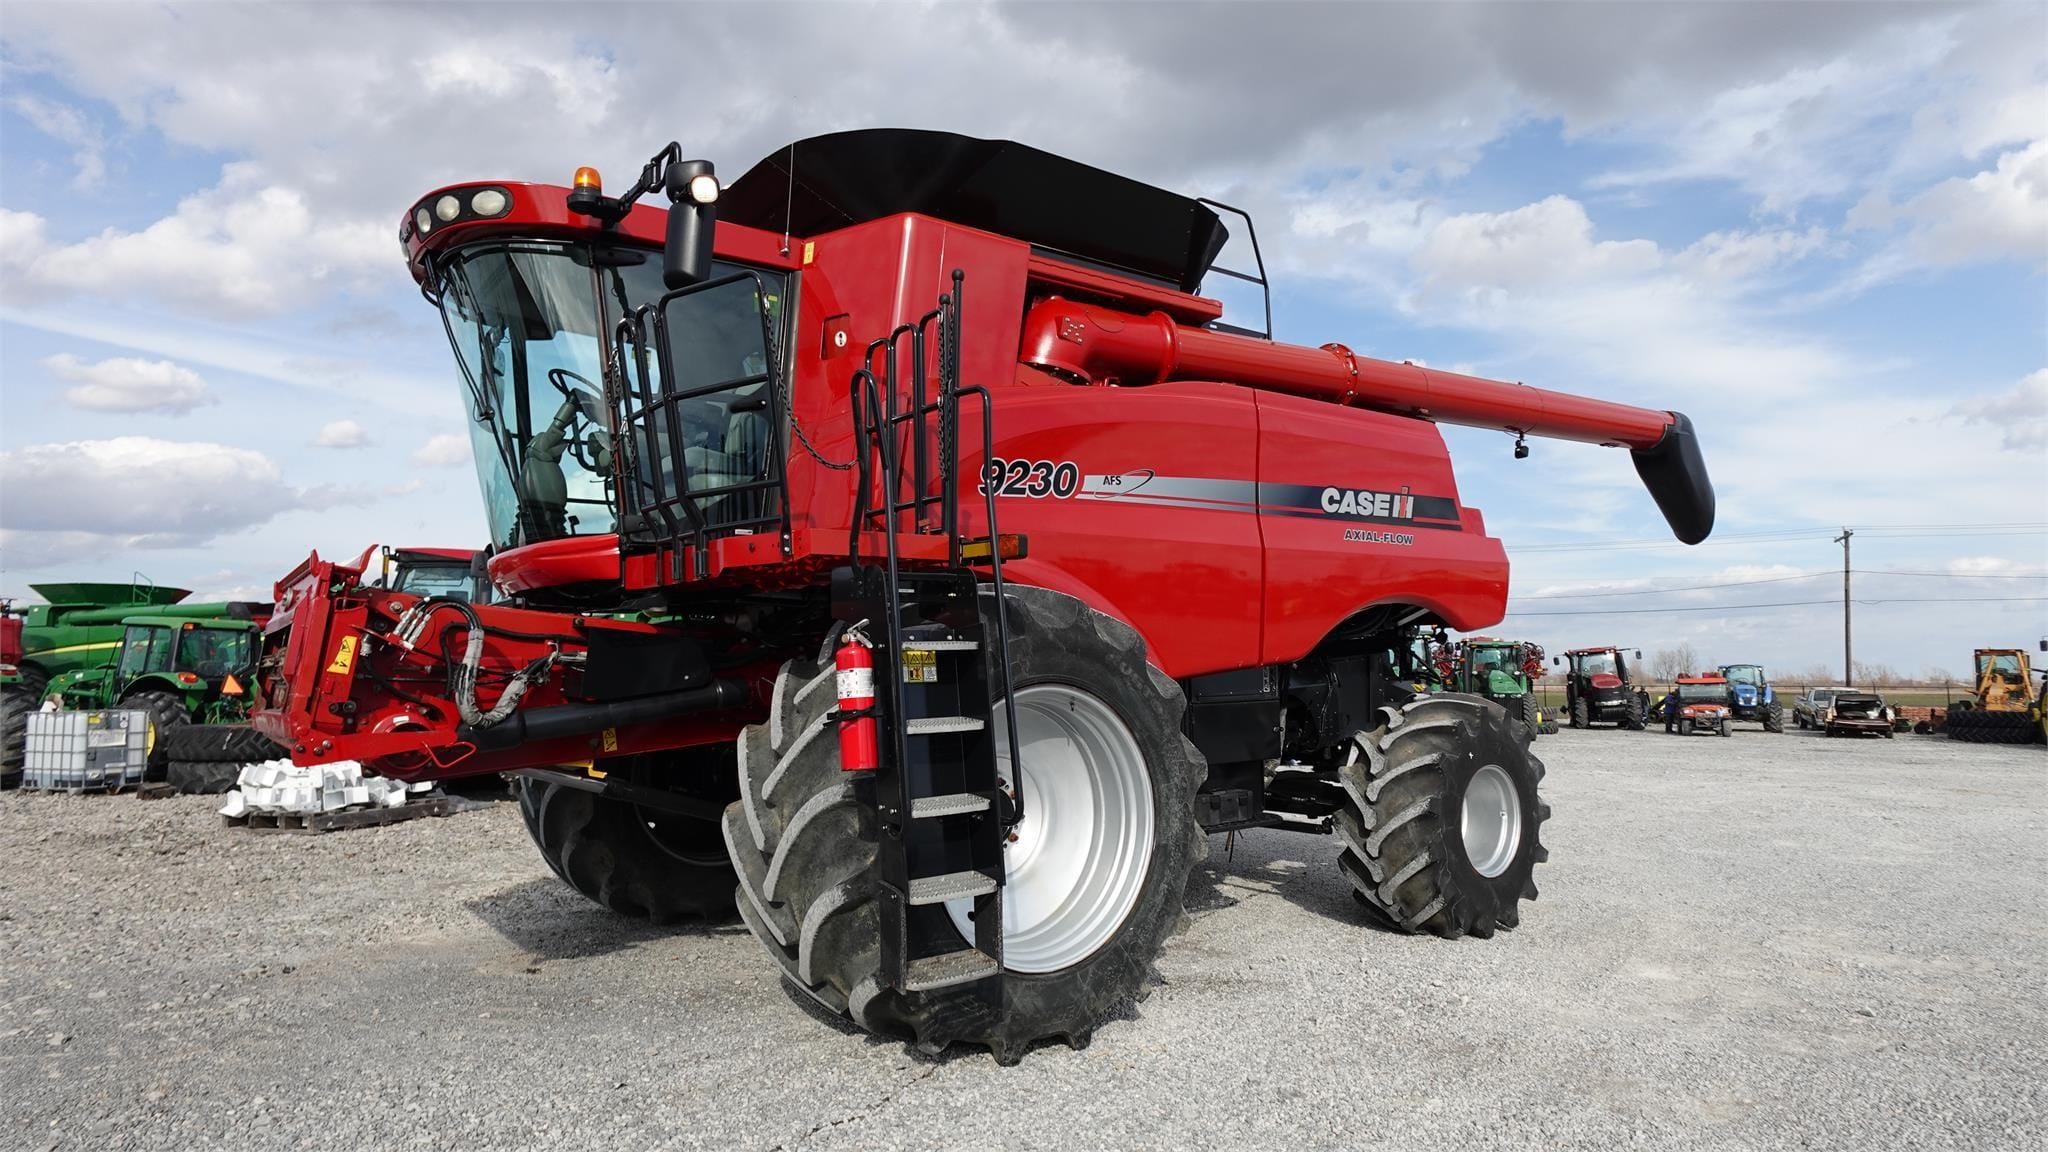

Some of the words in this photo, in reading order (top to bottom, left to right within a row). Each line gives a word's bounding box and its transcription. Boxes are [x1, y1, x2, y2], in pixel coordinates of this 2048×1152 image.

[978, 458, 1079, 499] 9230
[1102, 475, 1122, 486] AFS
[1321, 487, 1391, 517] CASE
[1344, 529, 1413, 545] AXIAL-FLOW
